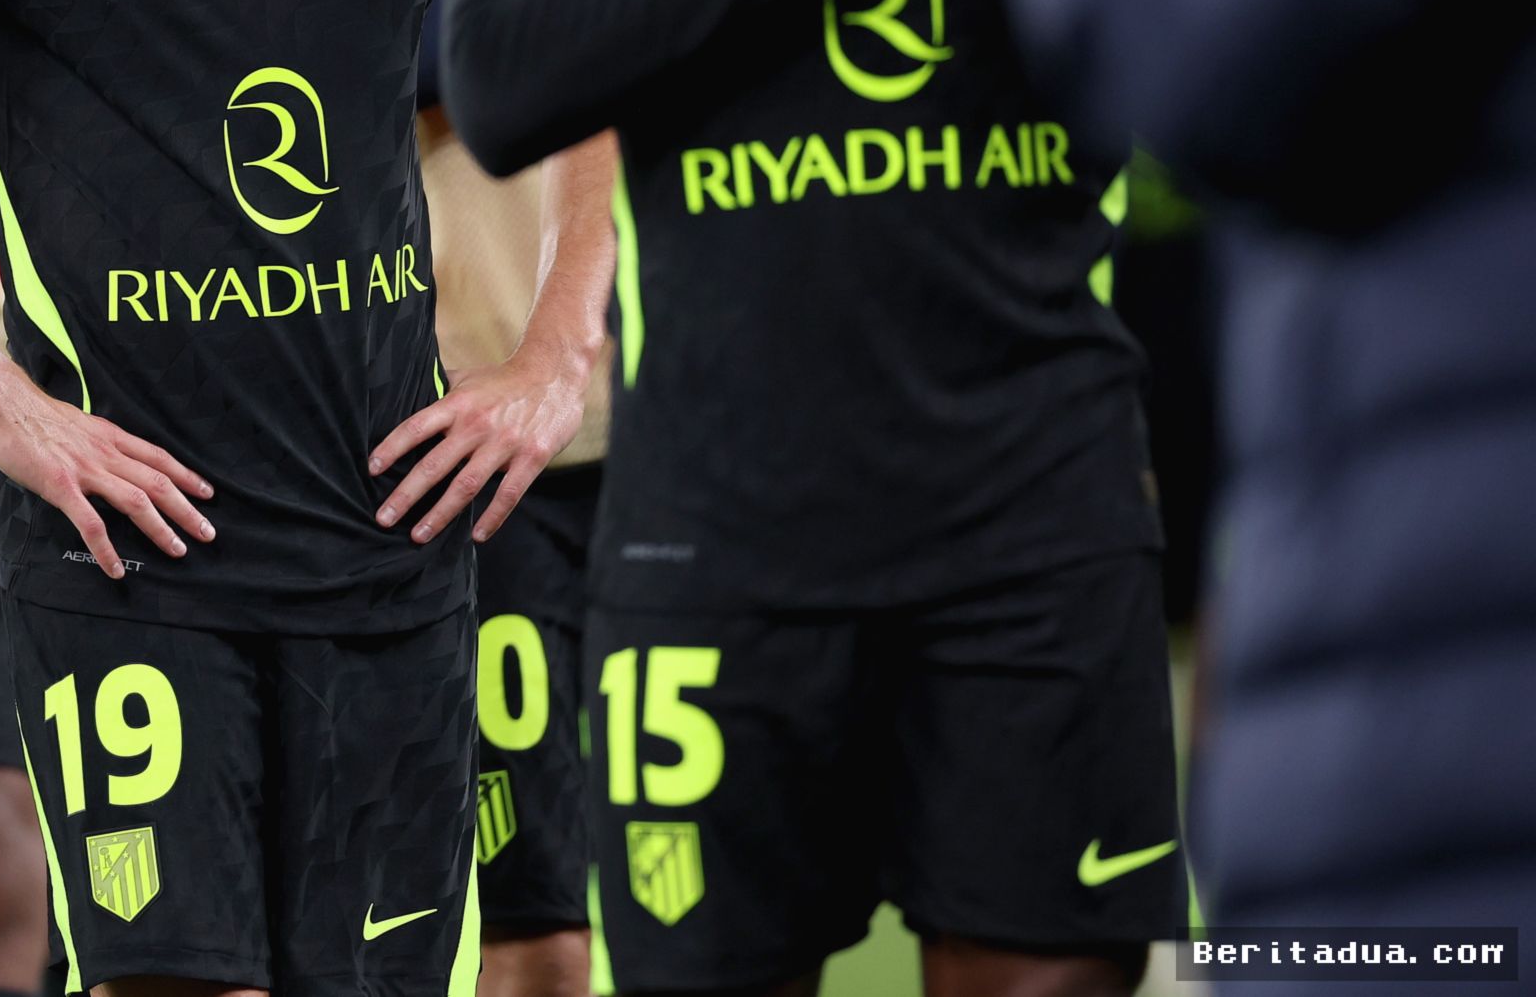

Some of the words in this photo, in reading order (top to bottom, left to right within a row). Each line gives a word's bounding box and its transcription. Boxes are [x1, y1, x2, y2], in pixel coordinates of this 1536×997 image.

[681, 125, 961, 215] RIYADH
[976, 123, 1074, 187] AIR
[107, 259, 351, 322] RIYADH
[367, 243, 429, 308] AIR
[62, 550, 145, 572] AERIT
[44, 663, 183, 817] 19
[599, 646, 725, 807] 15
